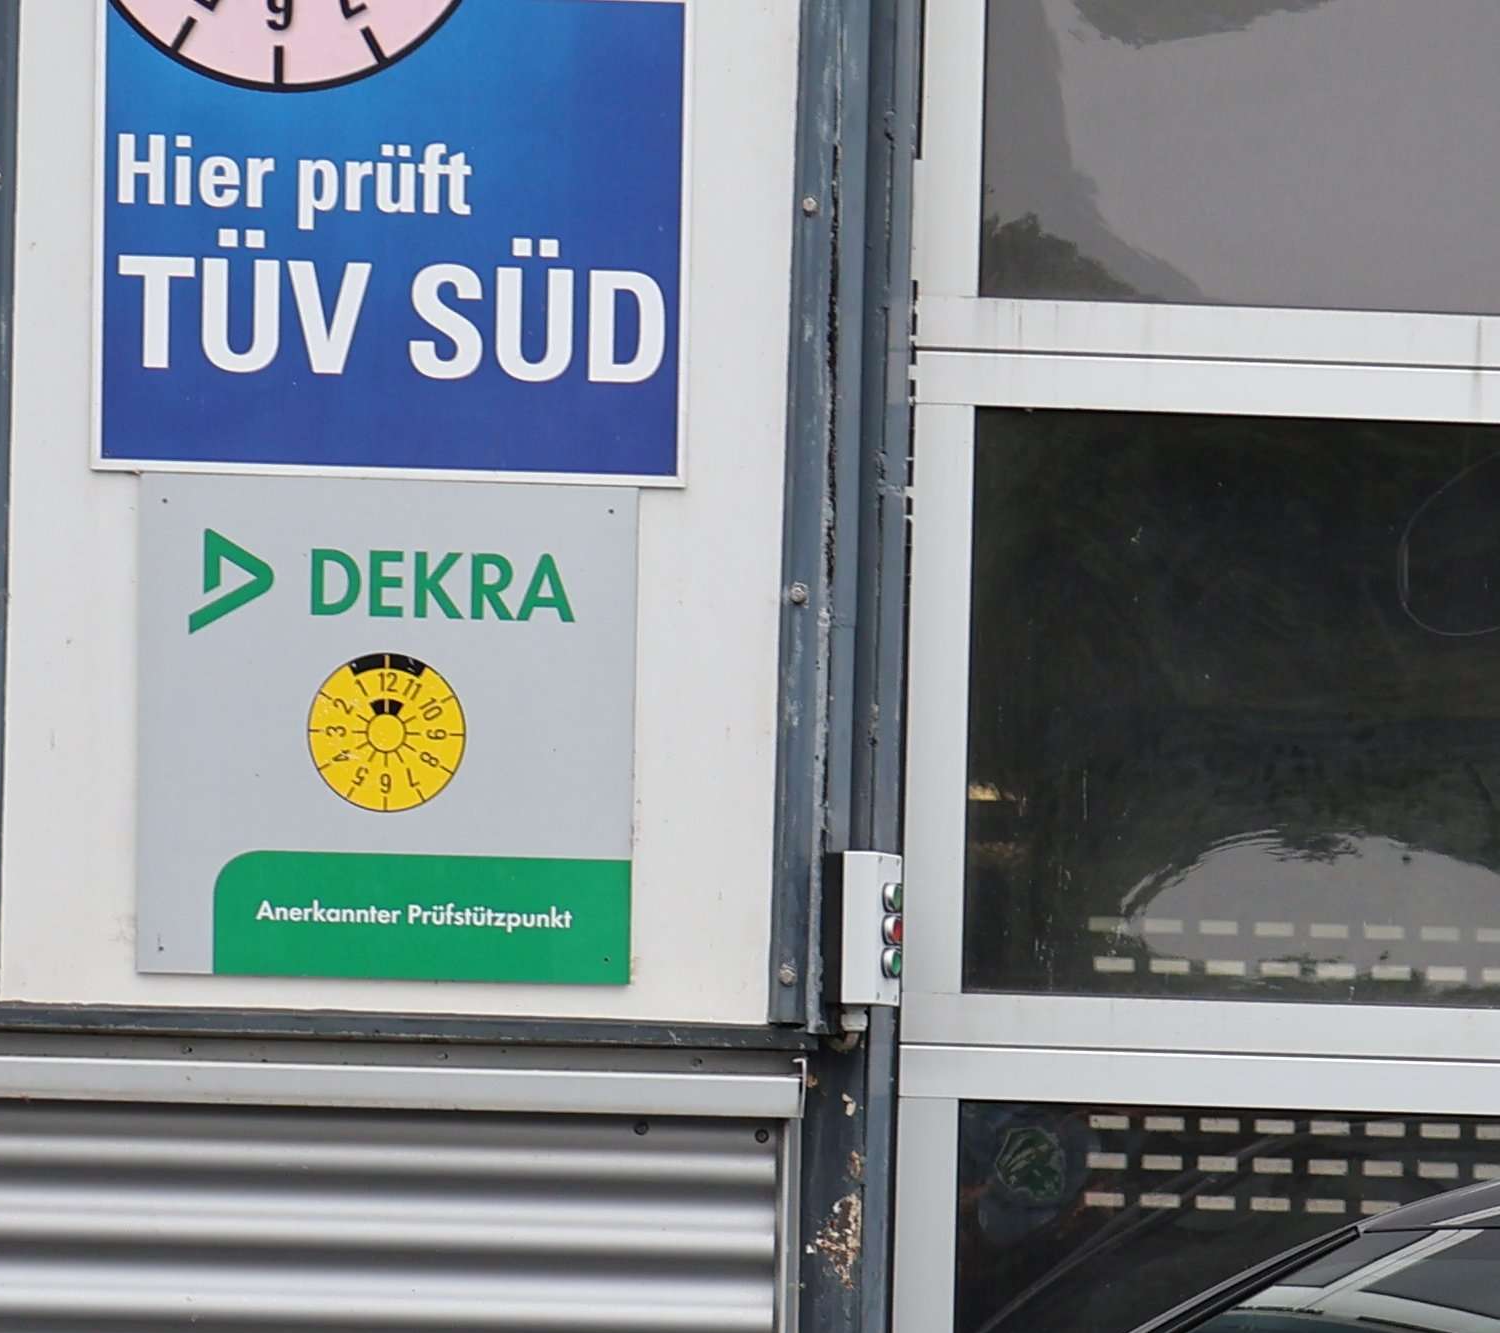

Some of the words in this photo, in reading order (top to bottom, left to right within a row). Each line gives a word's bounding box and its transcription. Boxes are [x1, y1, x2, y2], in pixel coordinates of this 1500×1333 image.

[117, 132, 275, 208] Hier
[297, 143, 472, 229] prüft
[117, 228, 373, 375] TÜV
[408, 237, 666, 383] SÜD
[310, 547, 576, 623] DEKRA
[378, 671, 398, 692] 12
[403, 678, 423, 701] 11
[255, 900, 402, 927] Anerkannter
[408, 902, 573, 934] Prüfstützpunkt
